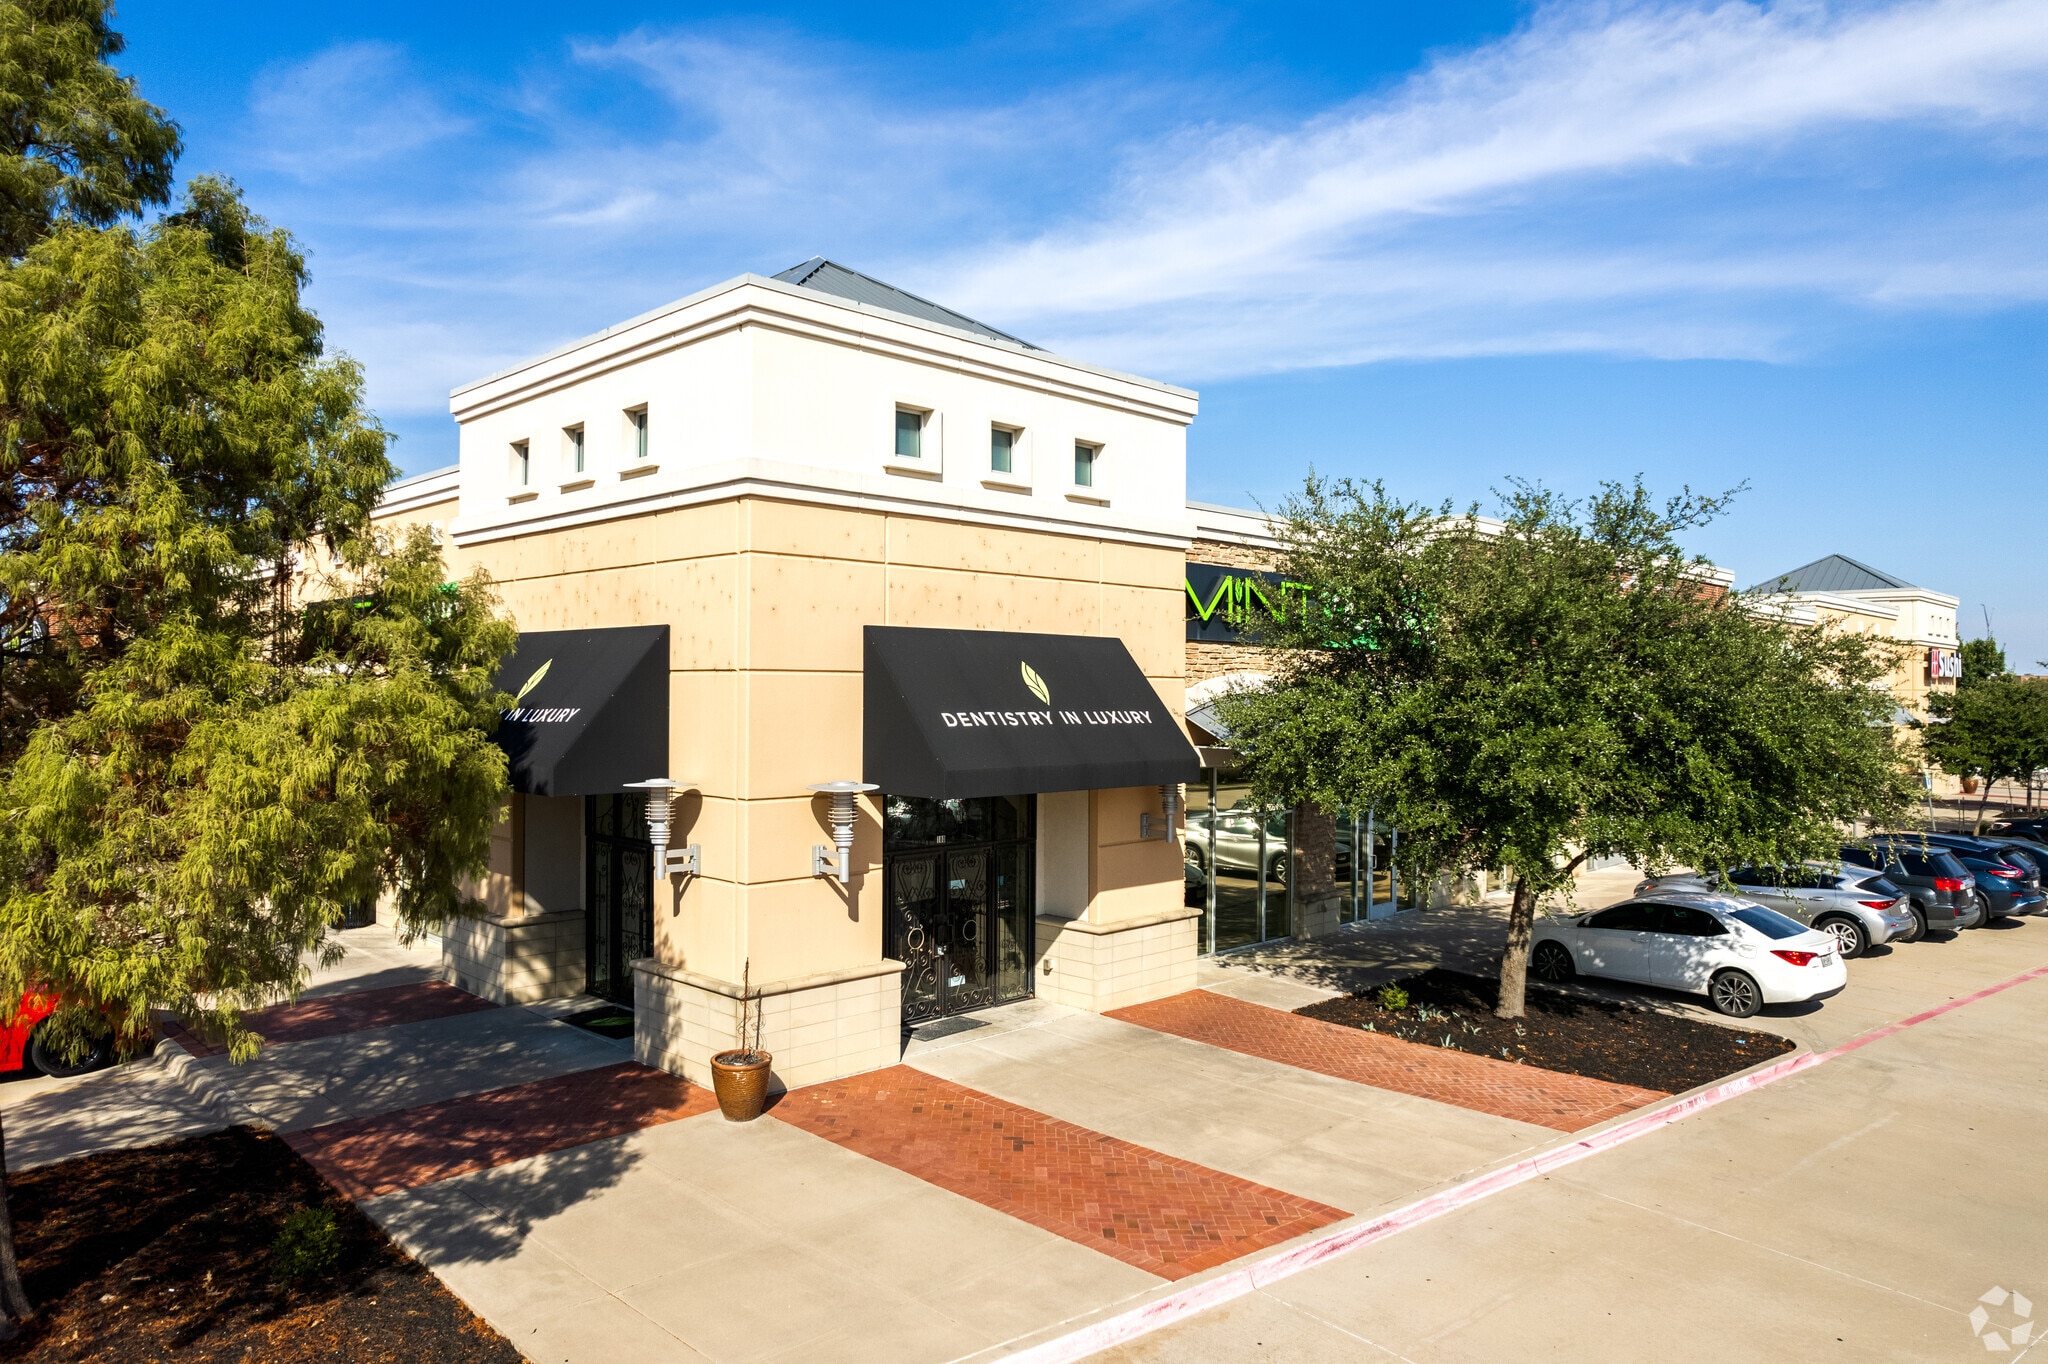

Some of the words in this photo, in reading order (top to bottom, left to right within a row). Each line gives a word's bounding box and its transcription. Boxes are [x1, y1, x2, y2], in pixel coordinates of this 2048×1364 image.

[1185, 575, 1313, 628] MINT
[1939, 651, 1962, 677] Sushi
[505, 708, 525, 721] IN
[522, 708, 580, 722] LUXURY
[941, 711, 1053, 727] DENTISTRY
[1059, 711, 1082, 725] IN
[1084, 711, 1152, 725] LUXURY
